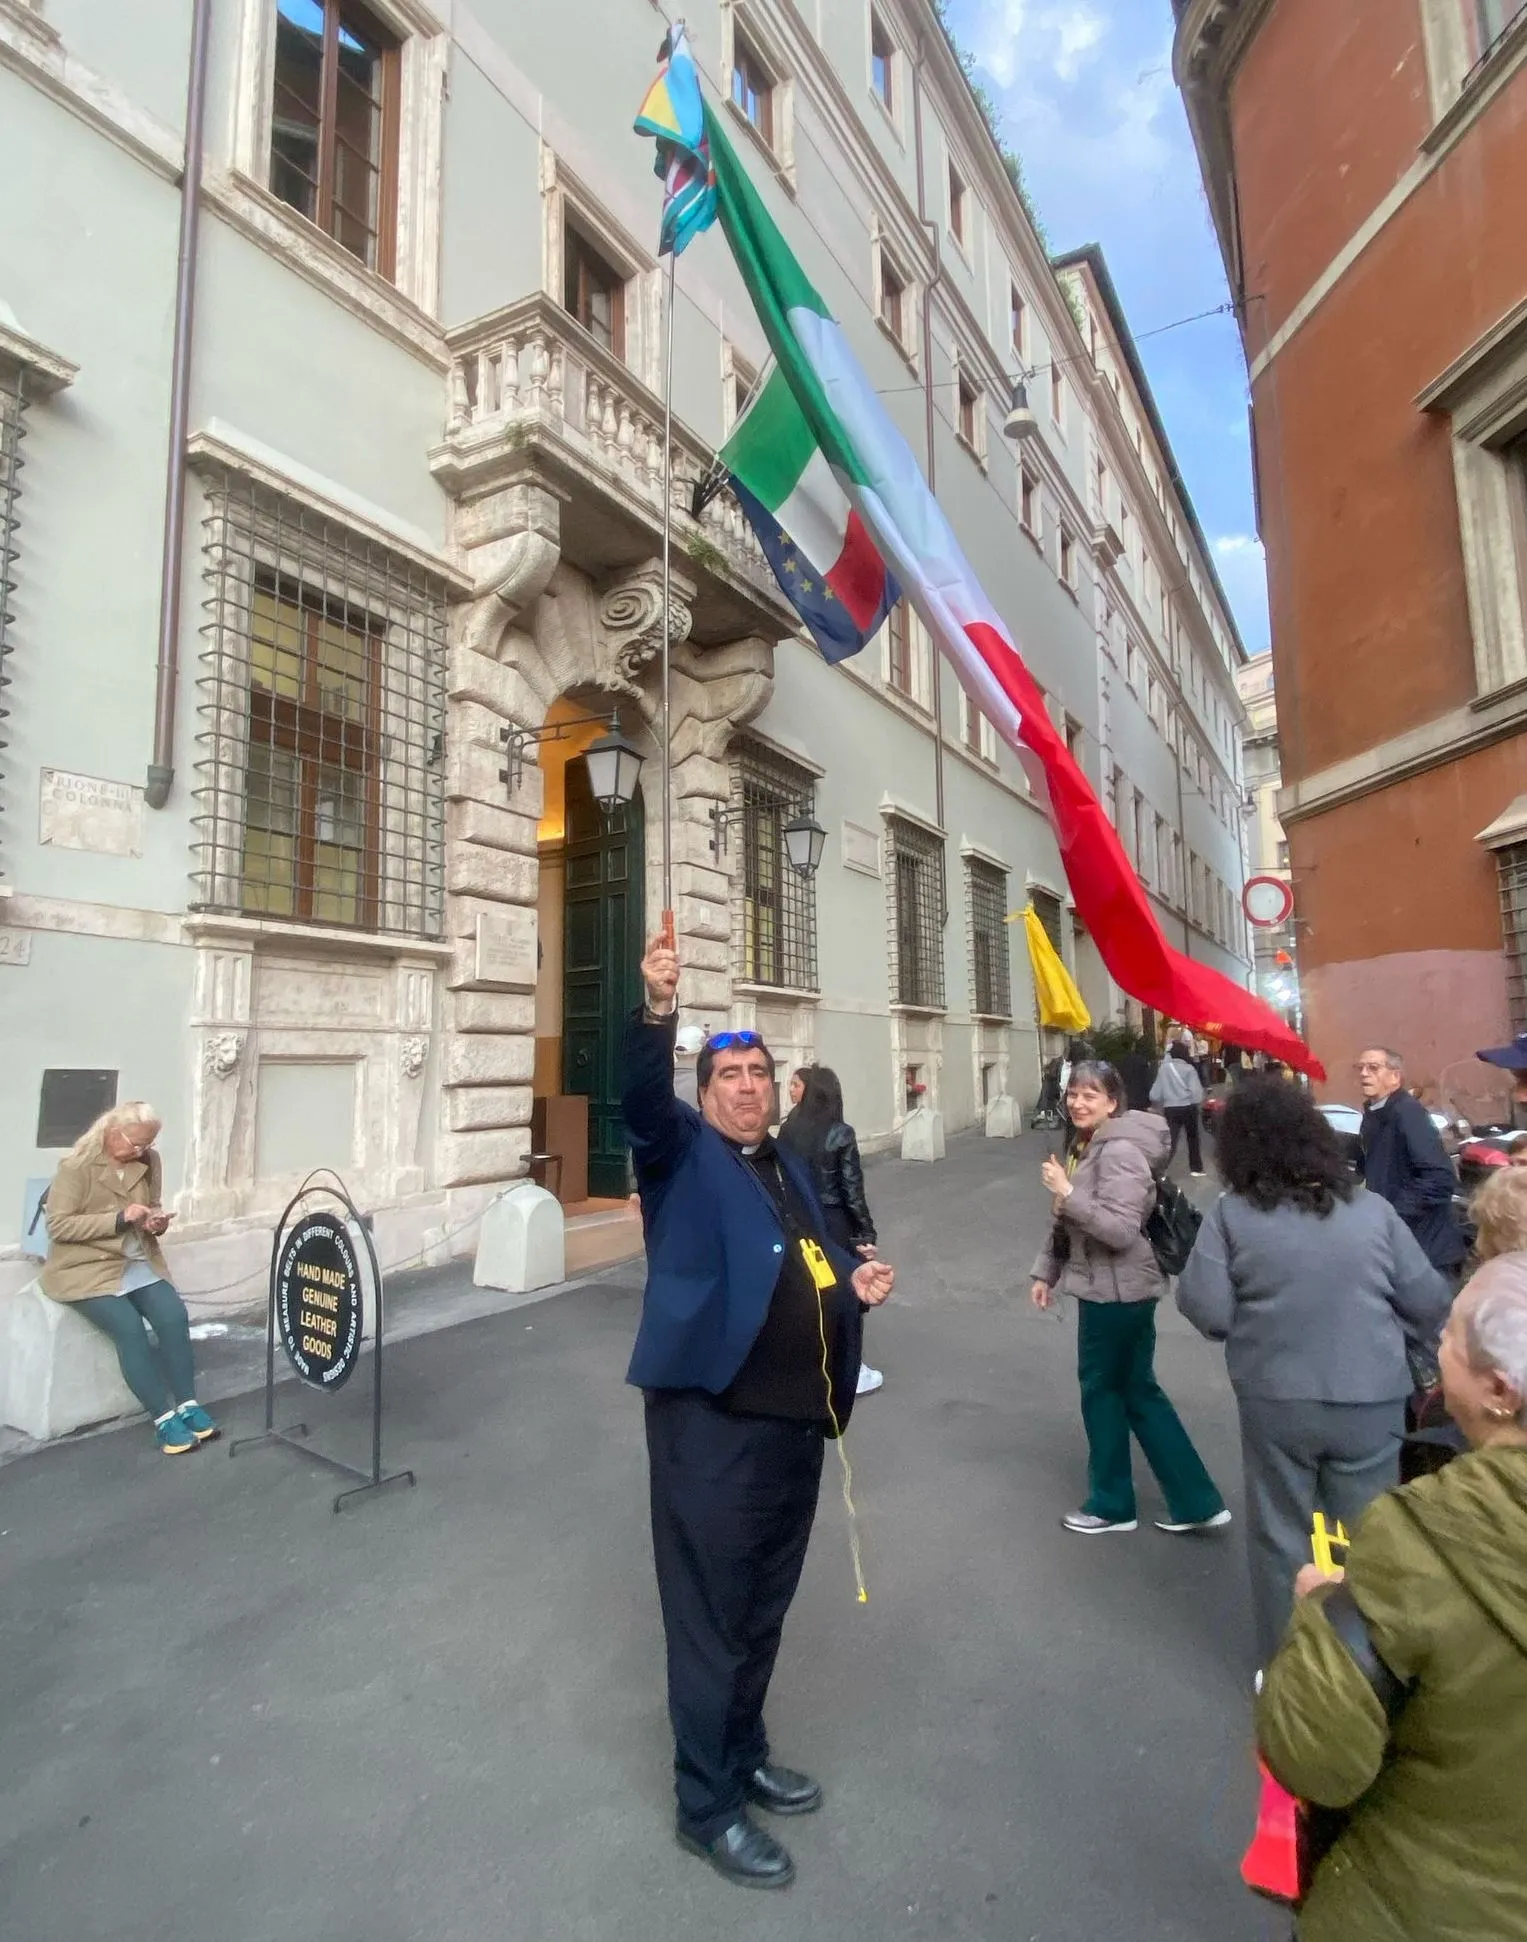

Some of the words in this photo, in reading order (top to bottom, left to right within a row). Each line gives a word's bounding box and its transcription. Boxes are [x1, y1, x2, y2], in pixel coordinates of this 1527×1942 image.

[52, 788, 132, 813] COLONNA
[303, 1226, 334, 1241] DIFFERENT
[284, 1247, 296, 1277] BELTS
[335, 1235, 354, 1278] COLOURS
[297, 1262, 320, 1281] HAND
[322, 1269, 346, 1290] MADE
[282, 1281, 290, 1332] MEASURE
[302, 1287, 338, 1312] GENUINE
[300, 1310, 337, 1337] LEATHER
[344, 1312, 357, 1359] ARTISTIC
[288, 1336, 295, 1351] TO
[302, 1335, 332, 1360] GOODS
